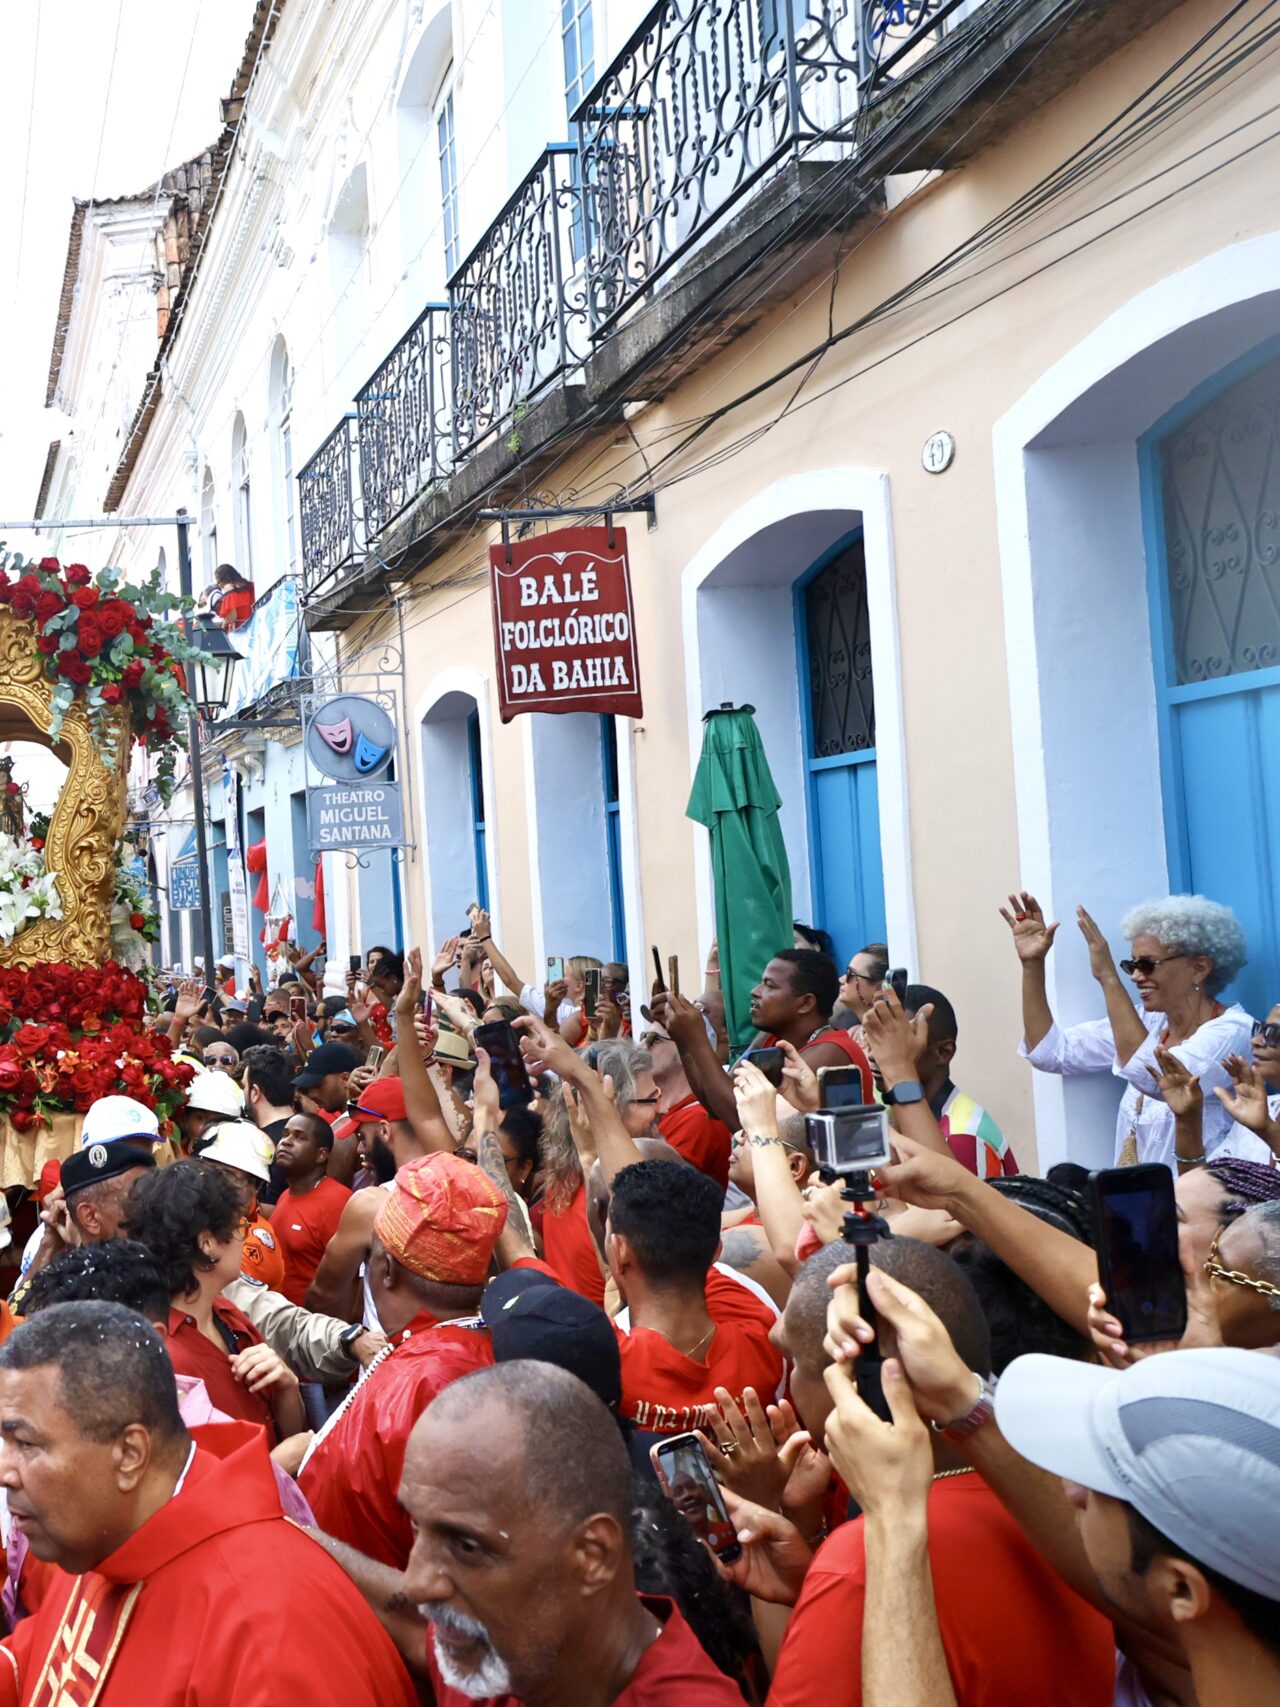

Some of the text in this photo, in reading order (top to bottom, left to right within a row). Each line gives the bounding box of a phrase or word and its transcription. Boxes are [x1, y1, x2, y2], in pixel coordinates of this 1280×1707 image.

[519, 562, 599, 607] BALÉ
[502, 608, 629, 651] FOLCLÓRICO
[511, 656, 630, 694] DA BAHIA
[323, 790, 385, 805] THEATRO
[320, 806, 389, 824] MIGUEL
[320, 824, 392, 842] SANTANA
[171, 888, 201, 901] BIMB
